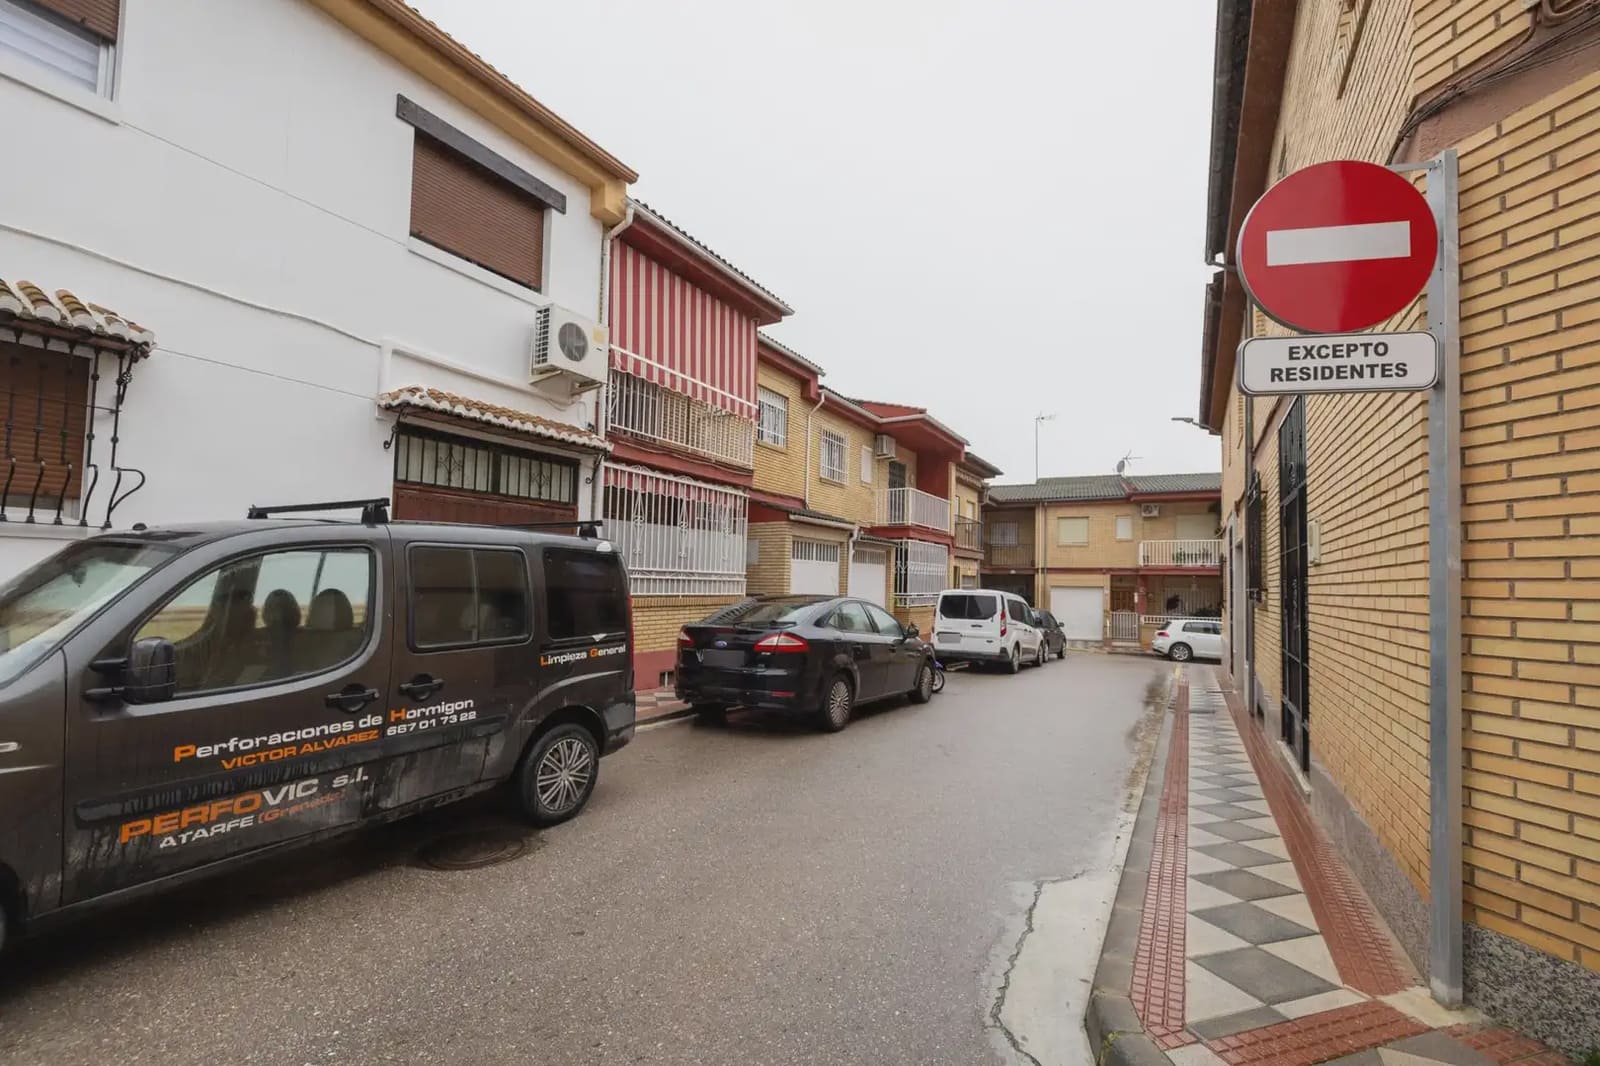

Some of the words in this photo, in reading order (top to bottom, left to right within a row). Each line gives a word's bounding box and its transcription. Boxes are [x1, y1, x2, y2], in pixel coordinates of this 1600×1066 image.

[1288, 341, 1388, 360] EXCEPTO
[1270, 362, 1408, 382] RESIDENTES
[540, 651, 587, 666] Limpieza
[590, 644, 626, 657] General
[173, 719, 354, 762] Perforaciones
[358, 714, 383, 728] de
[390, 699, 474, 722] Hormigon
[221, 748, 297, 770] VICTOR
[299, 729, 379, 756] ALVAREZ
[387, 722, 417, 736] 667
[419, 719, 436, 730] 01
[440, 714, 457, 725] 73
[460, 711, 477, 721] 22
[119, 778, 319, 844] PERFOVIC
[159, 815, 255, 849] ATARFE
